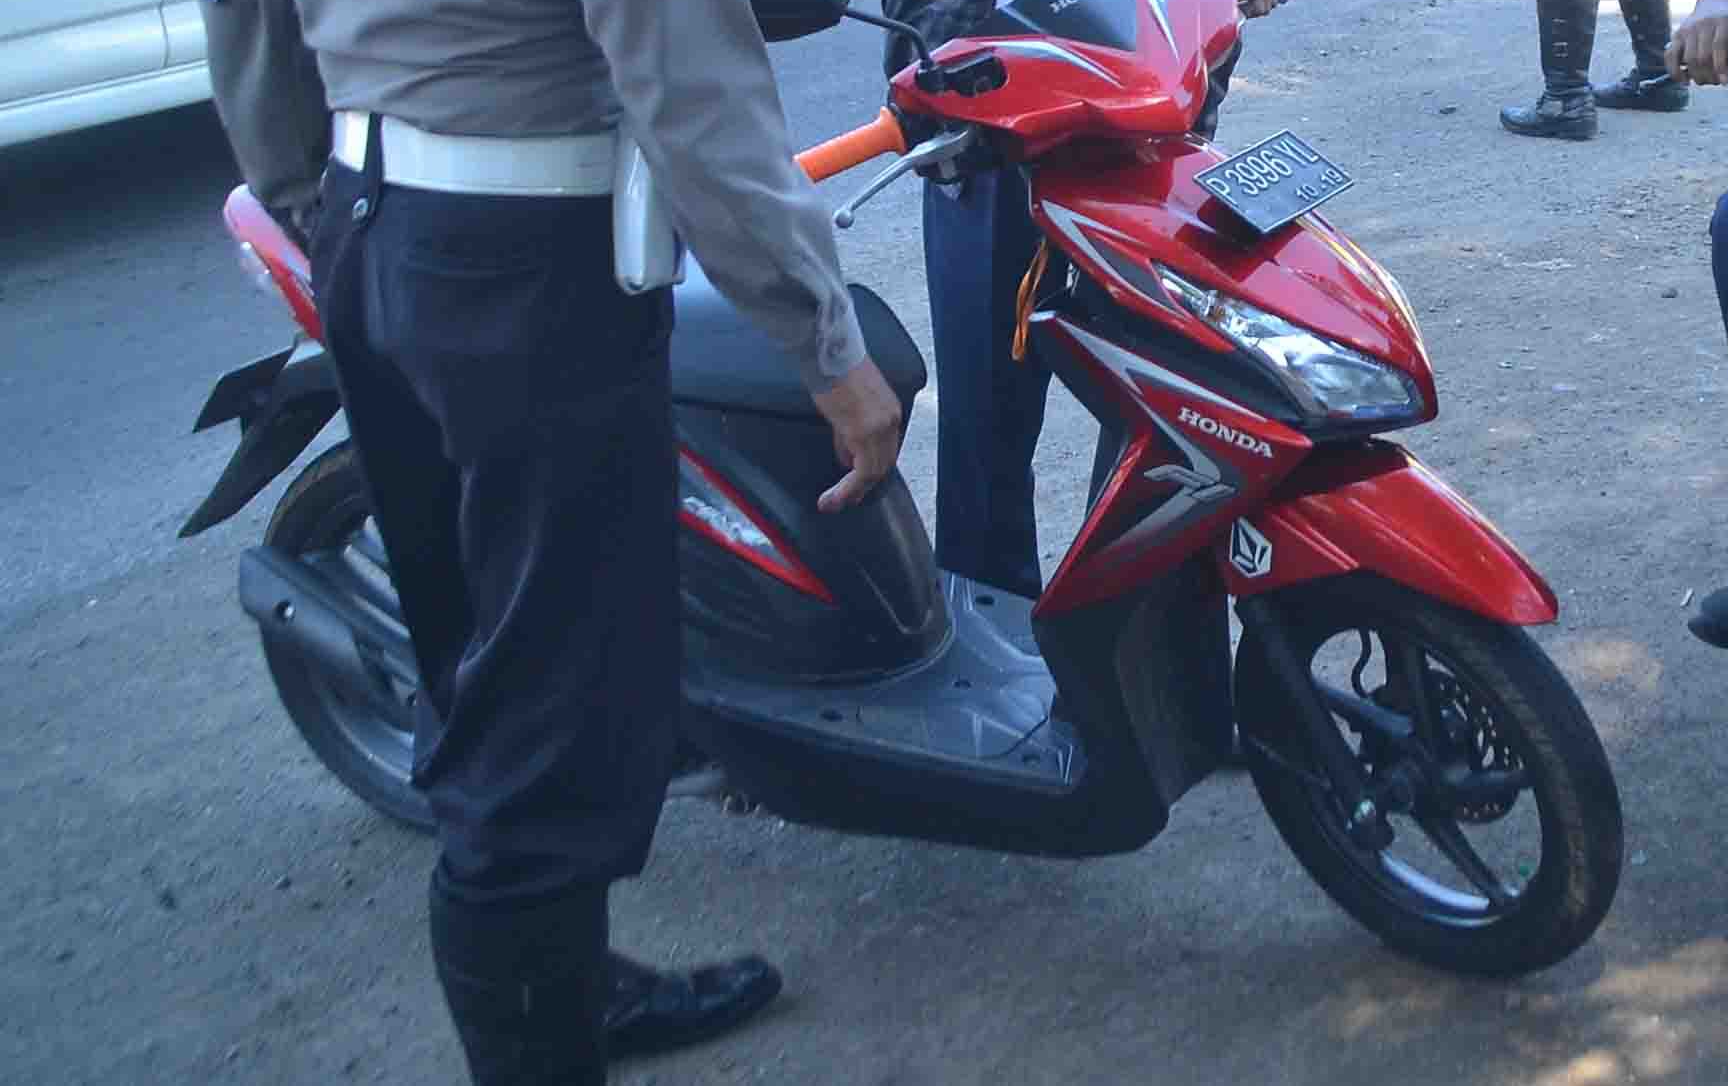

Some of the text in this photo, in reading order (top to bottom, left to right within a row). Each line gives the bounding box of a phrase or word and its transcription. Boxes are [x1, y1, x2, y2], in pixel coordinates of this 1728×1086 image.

[1206, 138, 1319, 206] P 3996 YL
[1178, 407, 1273, 458] HONDA
